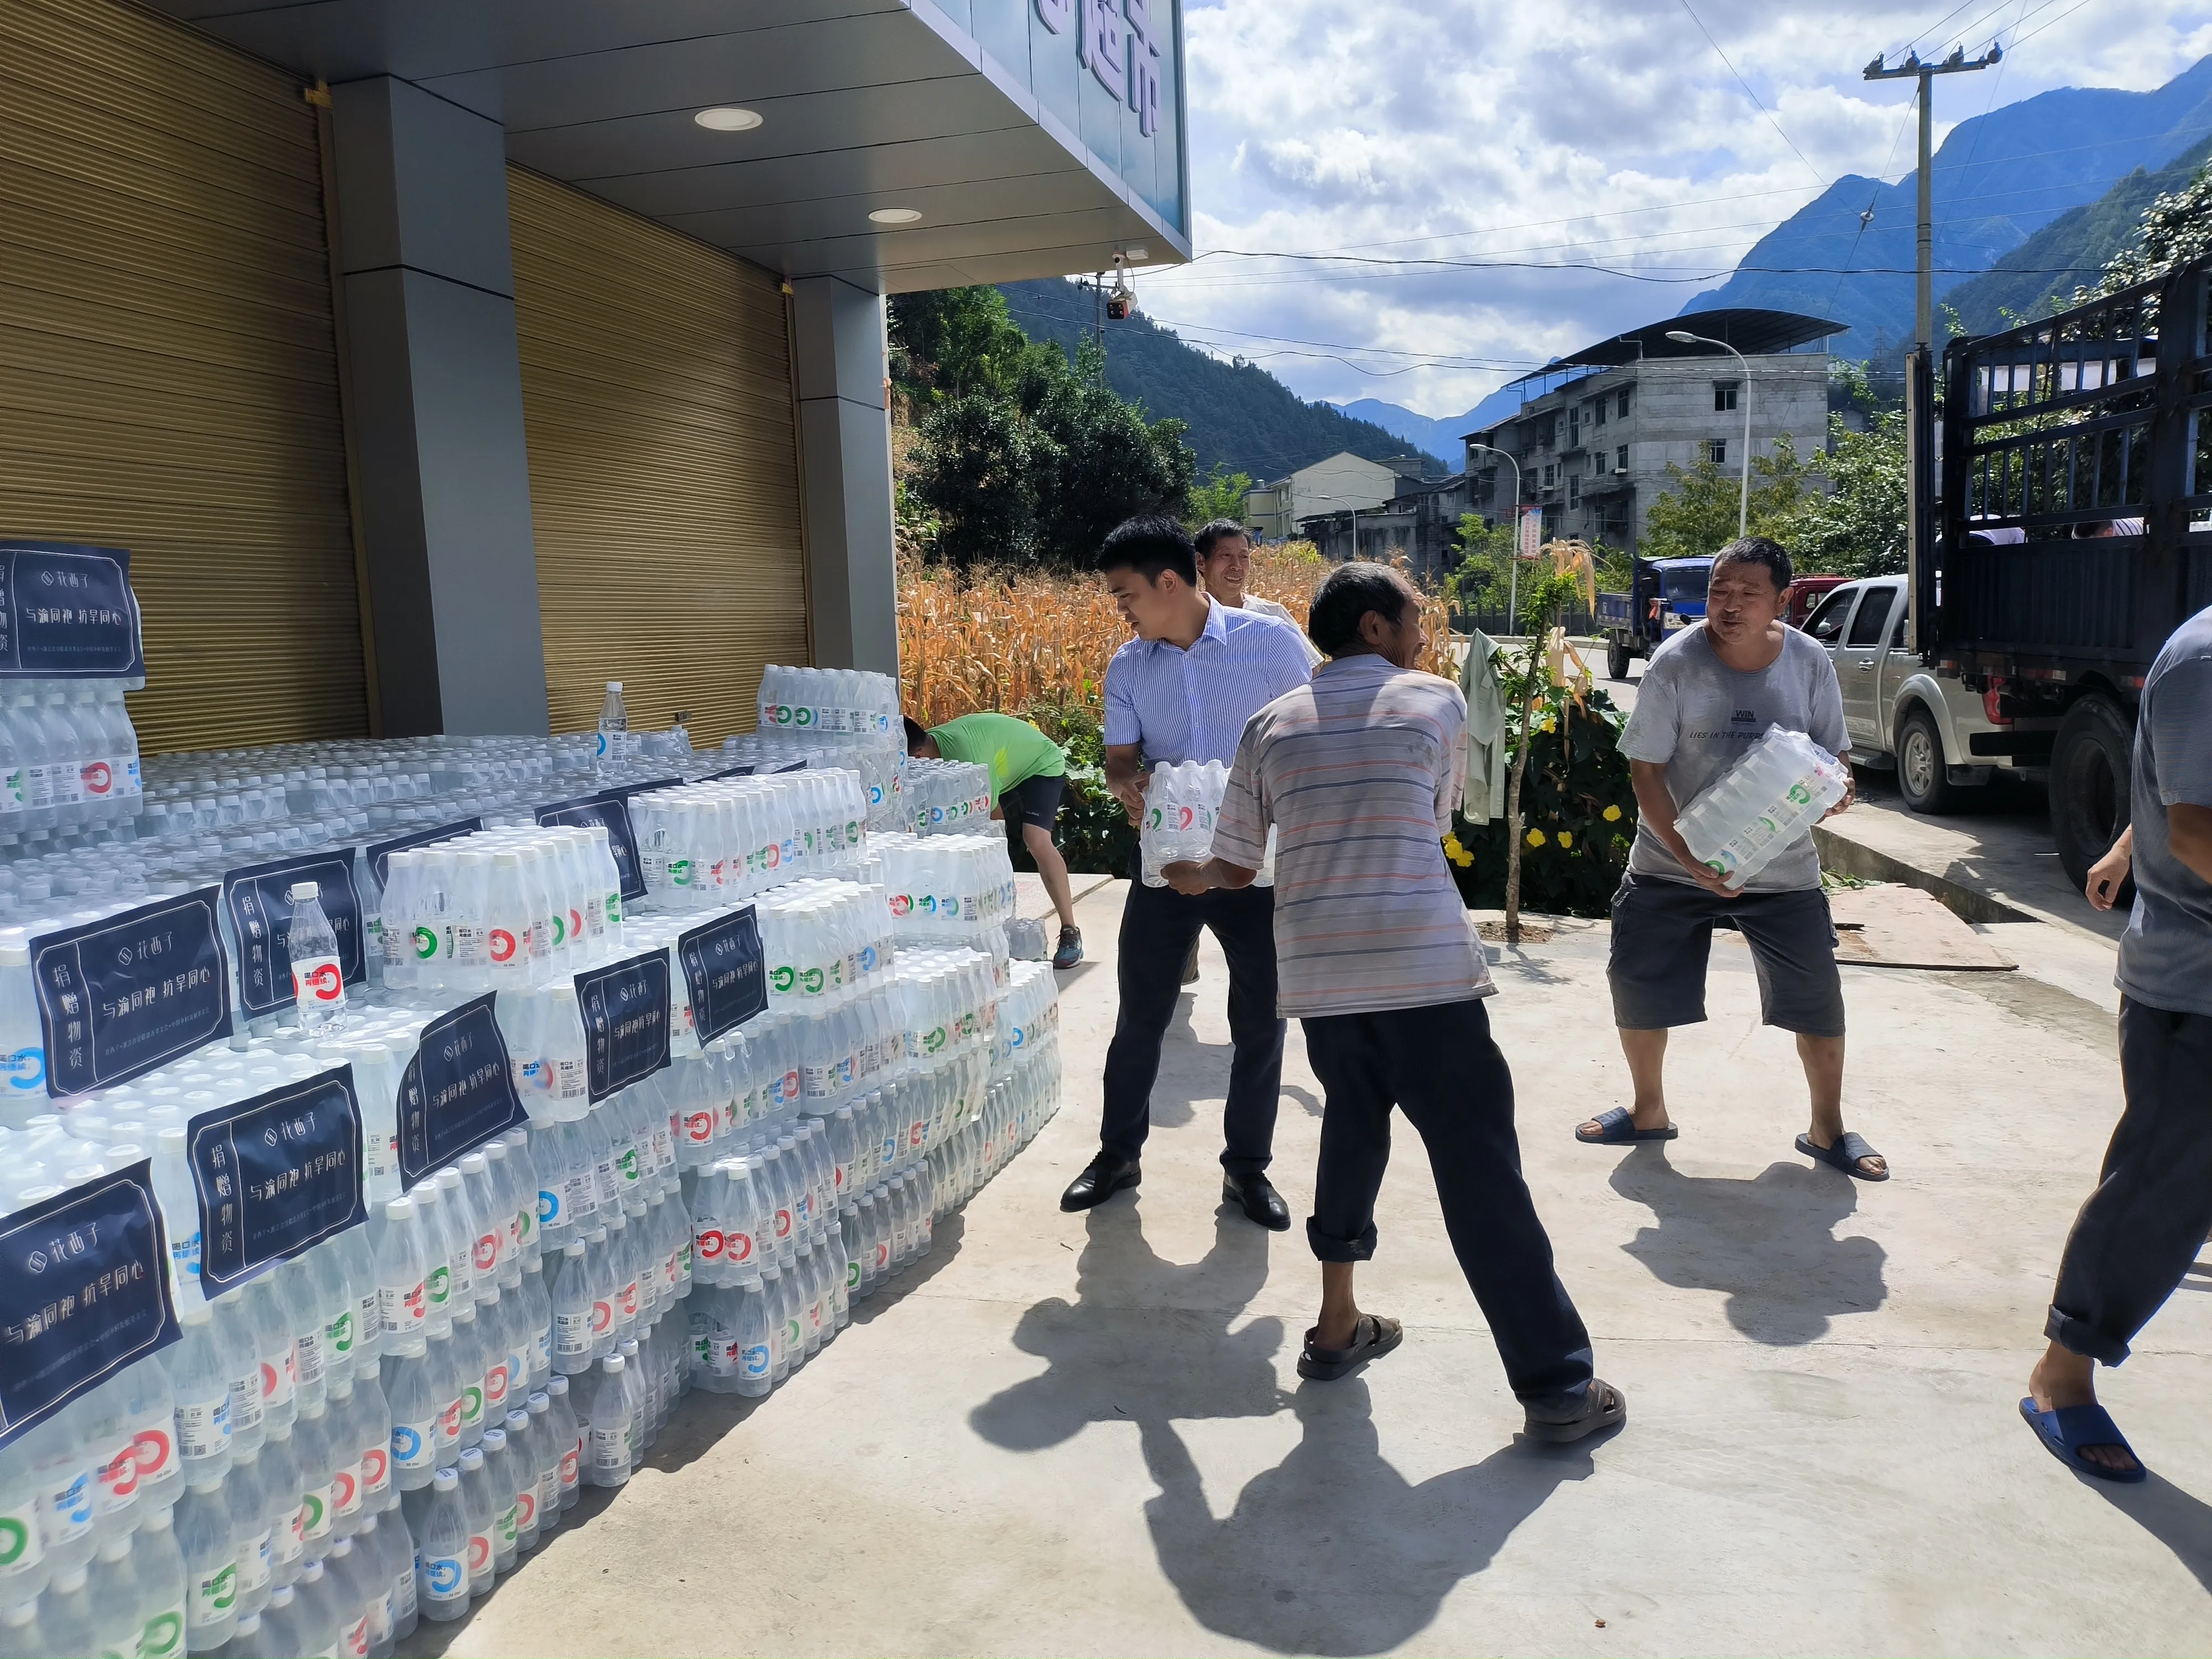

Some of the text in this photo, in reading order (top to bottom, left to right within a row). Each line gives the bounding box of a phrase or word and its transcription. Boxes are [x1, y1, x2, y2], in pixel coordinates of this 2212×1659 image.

[56, 571, 88, 588] 花西子
[26, 607, 122, 625] 与渝同袍 抗旱同心
[1736, 710, 1754, 718] WIN
[137, 931, 174, 960] 花西子
[242, 896, 264, 988] 捐赠物资
[53, 964, 82, 1071] 捐赠物资
[103, 966, 210, 1019] 与渝同袍 抗旱同心
[591, 994, 605, 1076] 捐赠物资
[432, 1061, 500, 1108] 与渝同袍 抗旱同心
[281, 1112, 316, 1141] 花西子
[211, 1144, 233, 1255] 捐赠物资
[250, 1149, 346, 1202] 与渝同袍 抗旱同心
[49, 1222, 101, 1263] 花西子
[4, 1259, 143, 1345] 与渝同袍 抗旱同心
